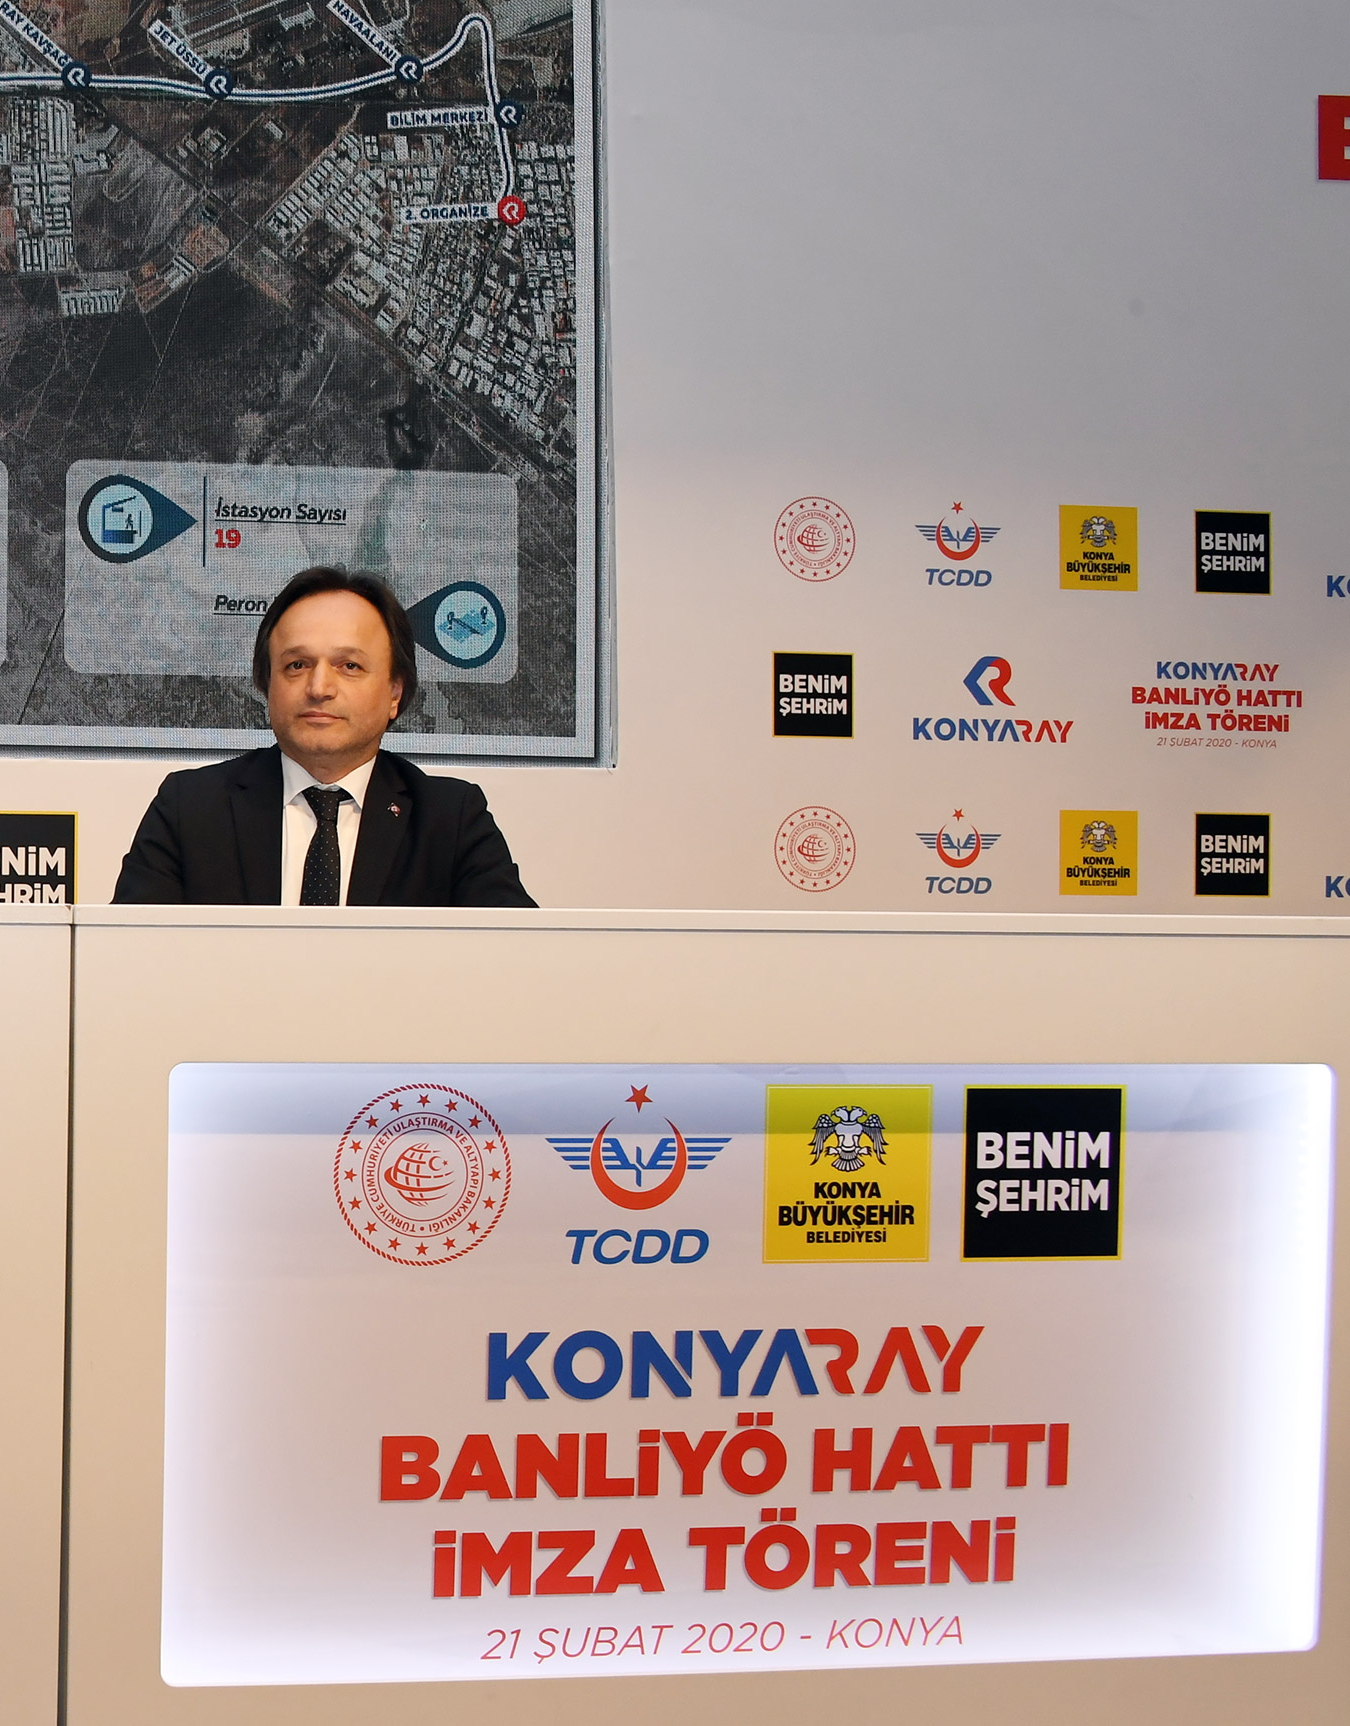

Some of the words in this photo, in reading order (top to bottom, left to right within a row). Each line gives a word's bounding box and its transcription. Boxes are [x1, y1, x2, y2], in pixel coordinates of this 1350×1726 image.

[153, 25, 176, 47] JET
[405, 209, 417, 221] 2.
[215, 497, 292, 520] İstasyon
[295, 503, 347, 523] Sayısı
[214, 529, 241, 549] 19
[1082, 551, 1115, 561] KONYA
[1066, 560, 1131, 575] BÜYÜKŞEHİR
[925, 568, 993, 587] TCDD
[214, 595, 268, 611] Peron
[1156, 661, 1279, 682] KONYARAY
[1237, 689, 1302, 708] HATTI
[912, 717, 1074, 743] KONYARAY
[1157, 737, 1167, 746] 21
[1169, 737, 1204, 748] ŞUBAT
[1206, 738, 1232, 747] 2020
[1241, 738, 1277, 748] KONYA
[1082, 856, 1115, 866] KONYA
[925, 877, 993, 894] TCDD
[392, 1116, 454, 1135] ULAŞTIRMA
[455, 1130, 467, 1144] VE
[464, 1144, 479, 1190] ALTYAPI
[814, 1181, 881, 1200] KONYA
[778, 1198, 915, 1230] BÜYÜKŞEHİR
[806, 1227, 887, 1243] BELEDİYESİ
[565, 1228, 709, 1264] TCDD
[487, 1325, 985, 1400] KONYARAY
[812, 1422, 1070, 1493] HATTI
[480, 1629, 520, 1661] 21
[532, 1625, 673, 1664] ŞUBAT
[682, 1620, 785, 1655] 2020
[825, 1615, 964, 1650] KONYA
